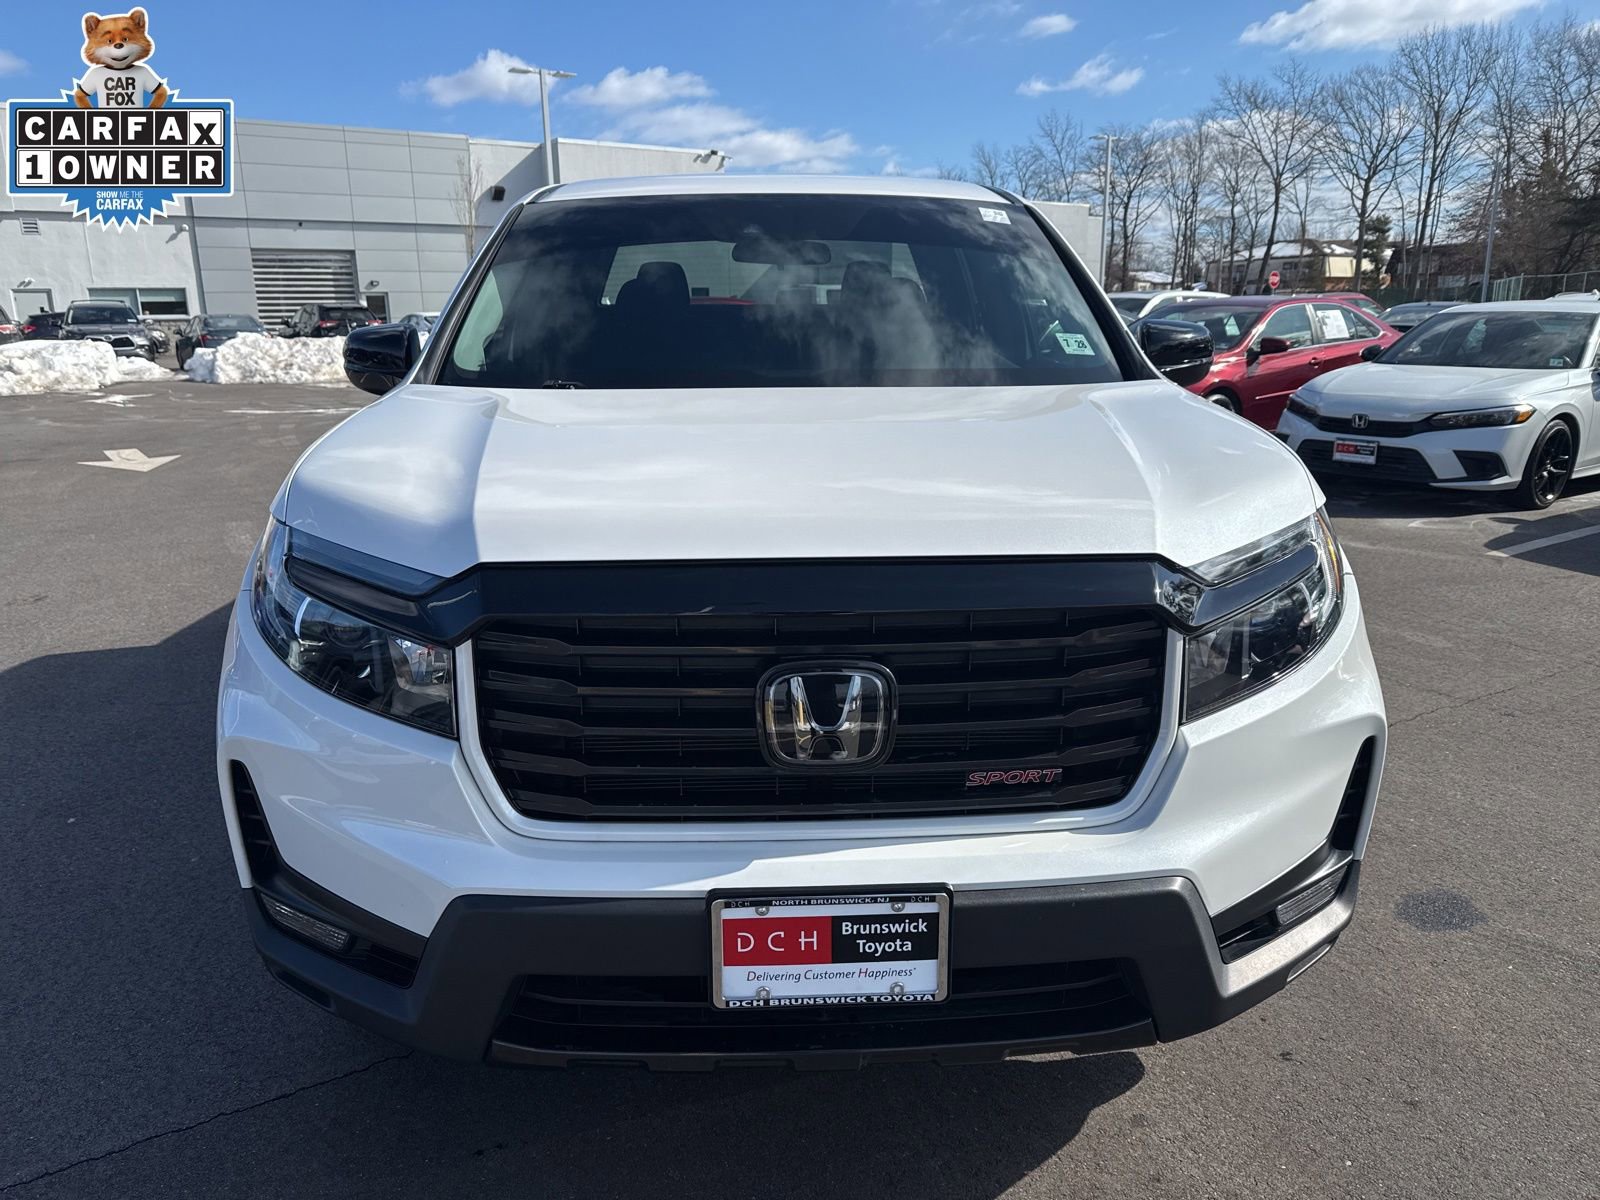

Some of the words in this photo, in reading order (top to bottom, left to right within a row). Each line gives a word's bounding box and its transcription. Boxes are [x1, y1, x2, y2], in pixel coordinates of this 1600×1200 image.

[965, 768, 1063, 787] SPORT
[841, 918, 928, 935] Brunswick
[856, 938, 912, 957] Toyota
[746, 970, 802, 983] Delivering
[803, 968, 856, 980] Customer
[728, 1000, 765, 1008] DCH
[769, 995, 867, 1006] BRUNSWICK
[870, 993, 934, 1003] TOYOTA
